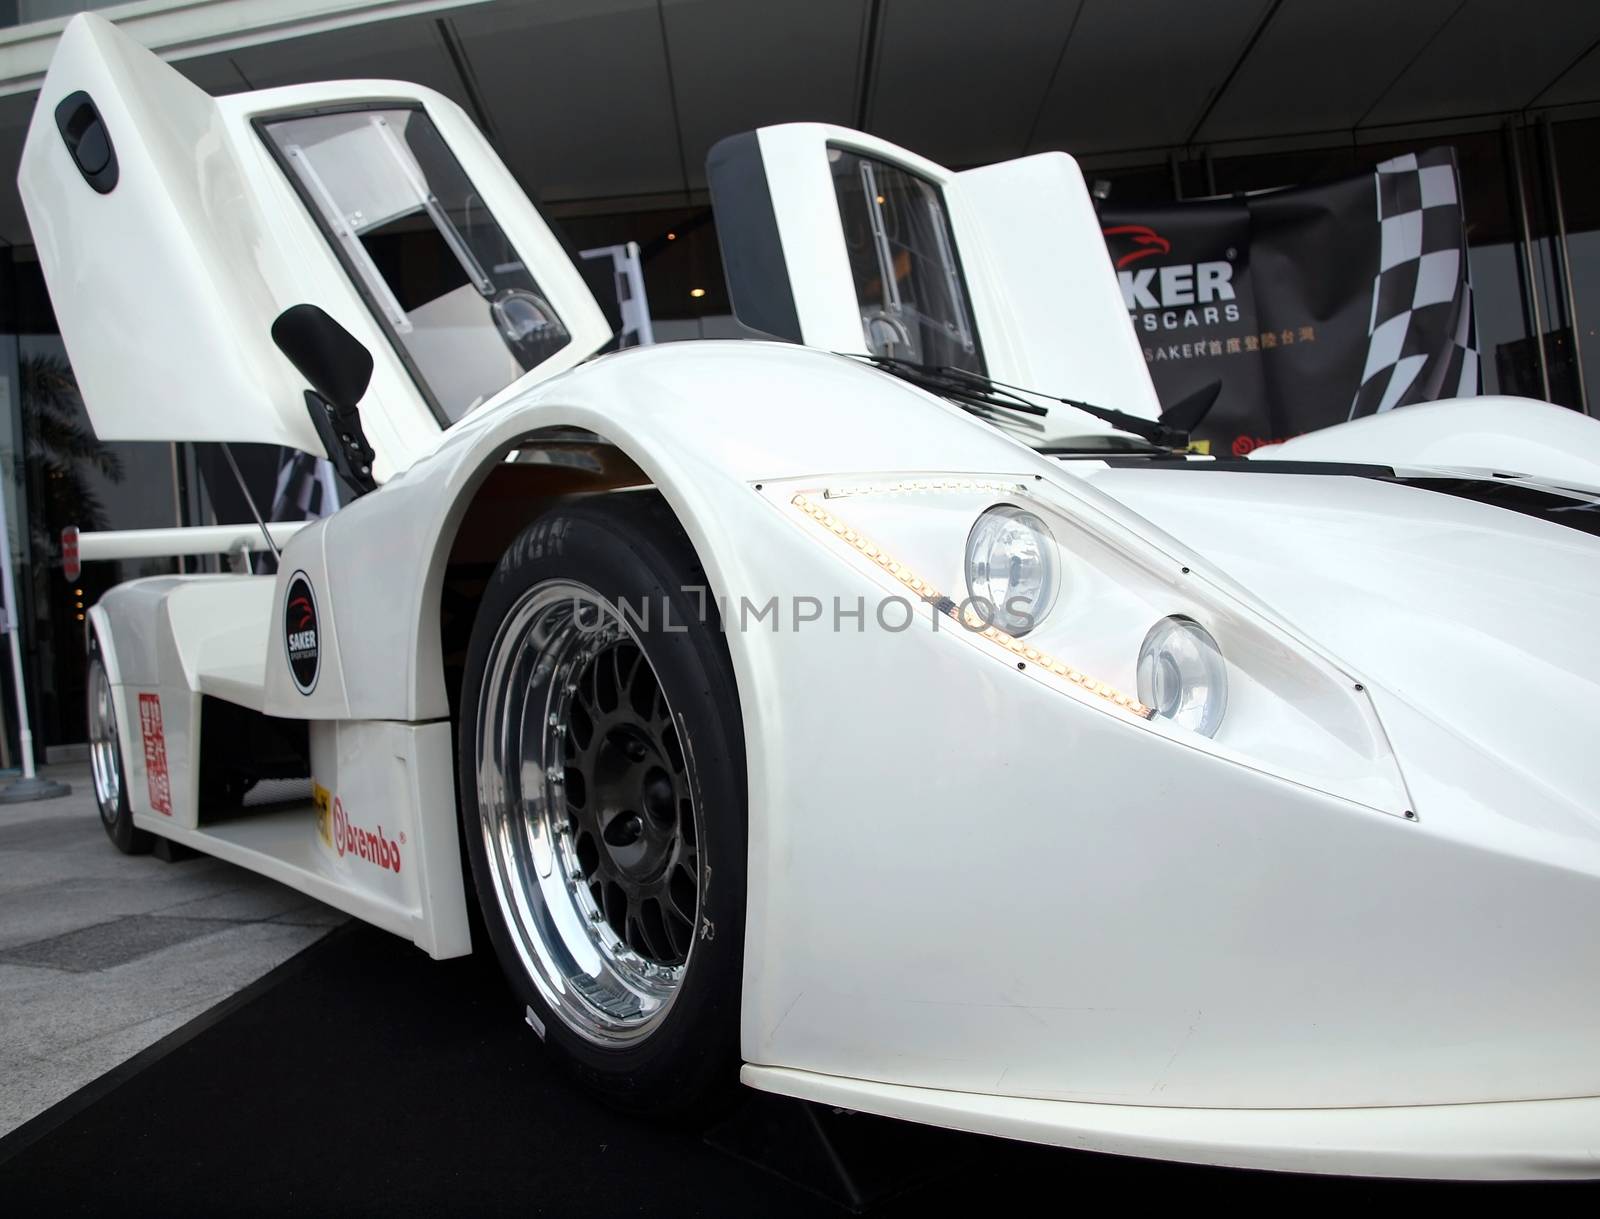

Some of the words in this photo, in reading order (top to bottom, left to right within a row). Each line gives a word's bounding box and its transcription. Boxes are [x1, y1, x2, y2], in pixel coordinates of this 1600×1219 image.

[1118, 261, 1236, 310] KER
[289, 630, 316, 651] SAKER
[345, 812, 401, 873] brembo
